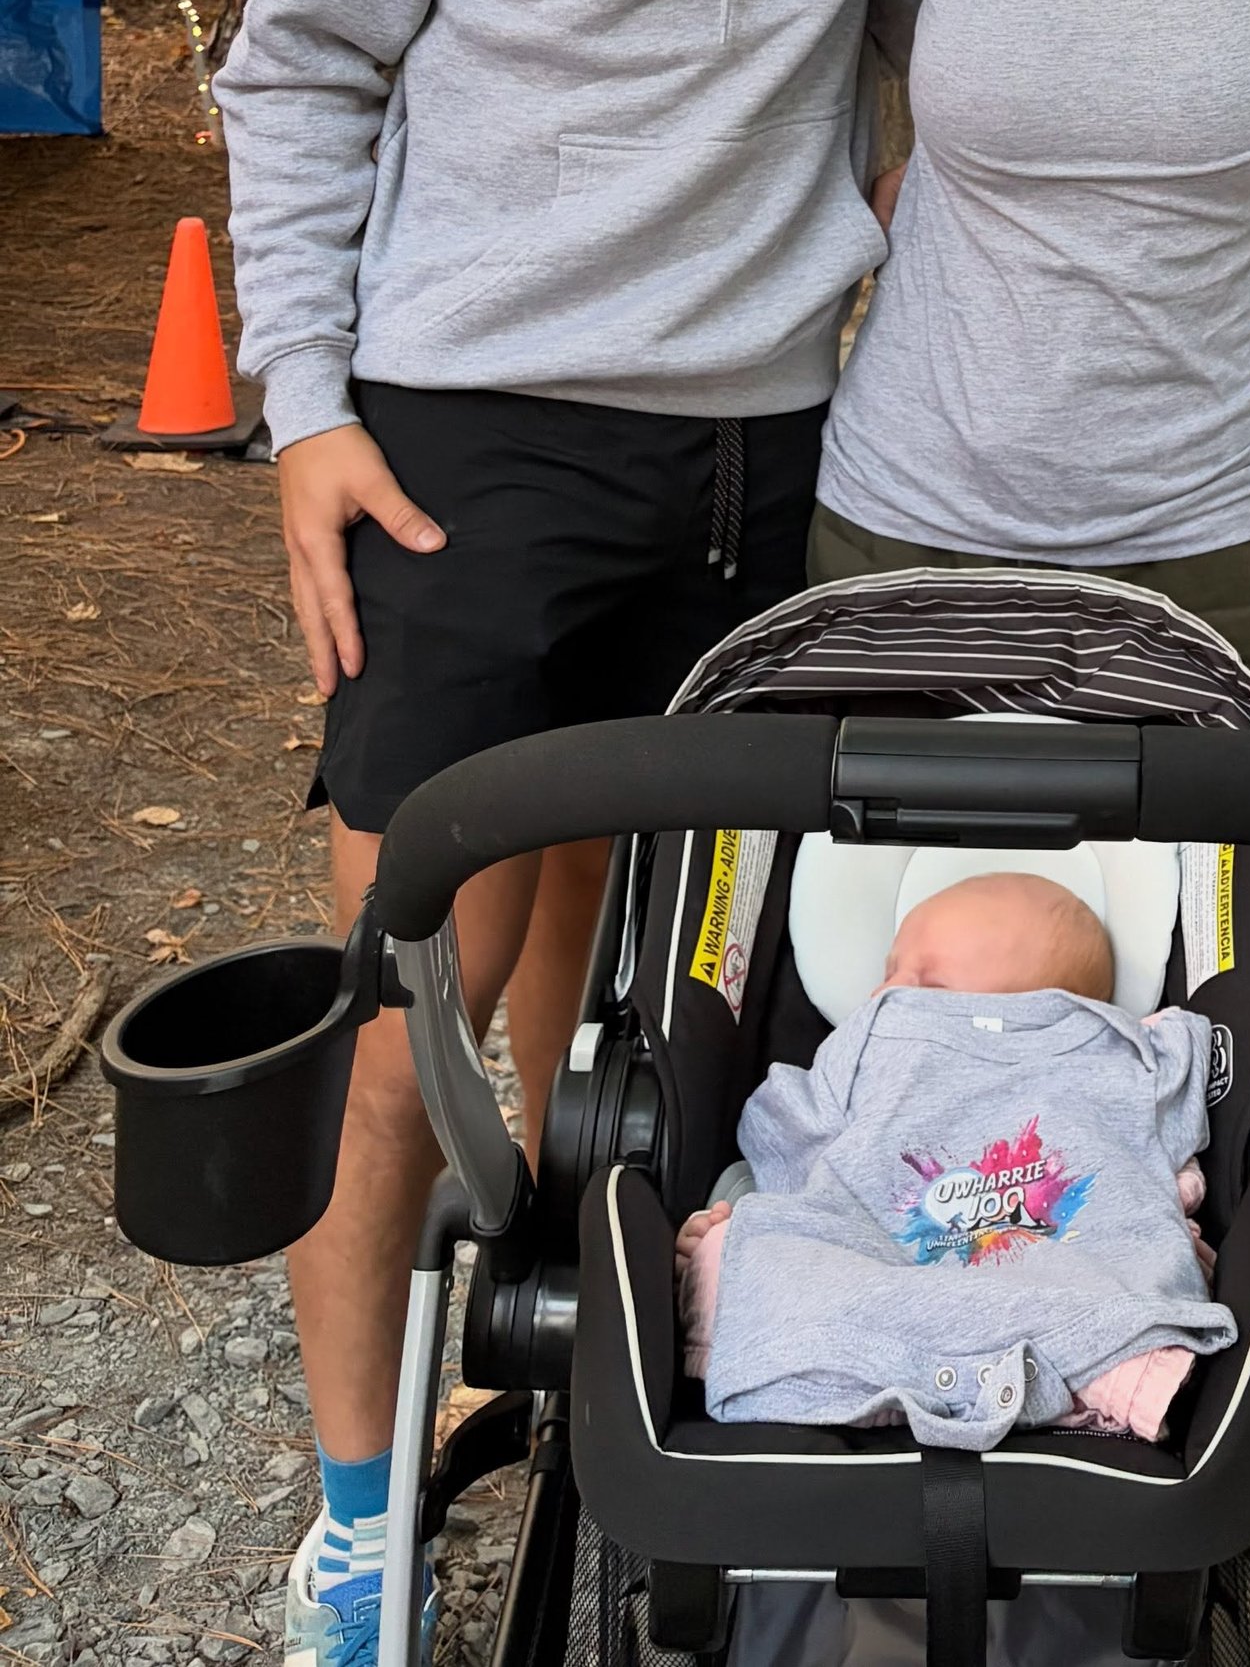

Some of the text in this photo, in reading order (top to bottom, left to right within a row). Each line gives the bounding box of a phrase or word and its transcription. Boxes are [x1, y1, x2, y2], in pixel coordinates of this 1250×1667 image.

[703, 879, 731, 957] WARNING
[1220, 868, 1231, 961] ADVERTENCIA
[935, 1160, 1047, 1203] UWHARRIE
[968, 1186, 1025, 1221] 100
